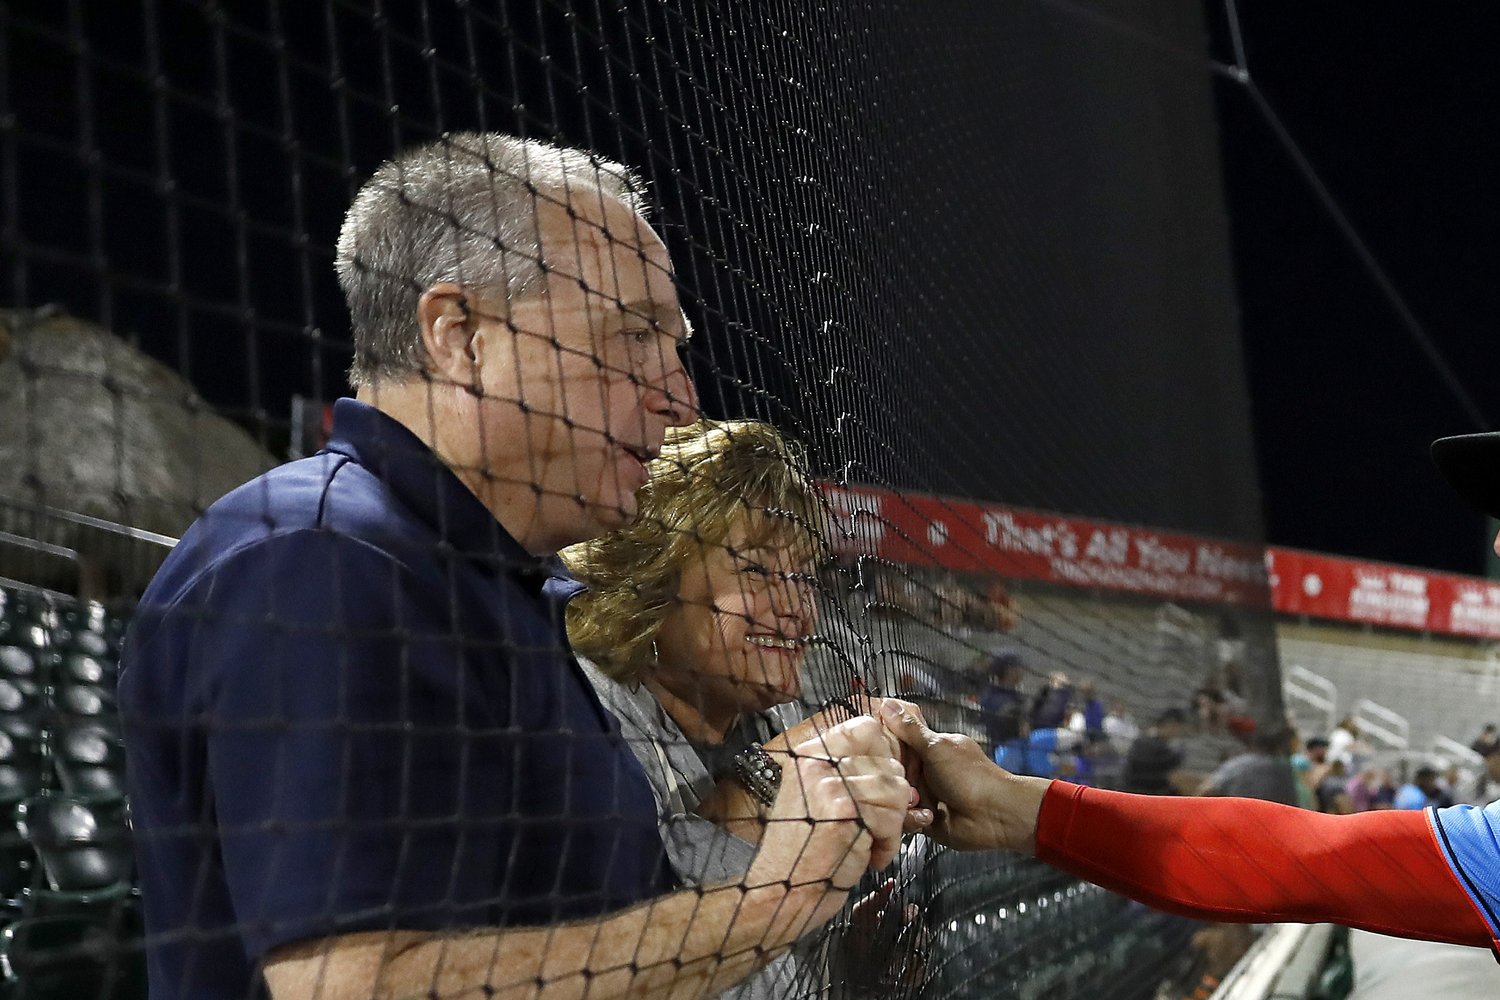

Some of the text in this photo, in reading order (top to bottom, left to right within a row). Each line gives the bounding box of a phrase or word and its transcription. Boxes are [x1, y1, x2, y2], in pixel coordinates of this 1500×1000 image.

[984, 511, 1078, 557] That's
[1087, 530, 1128, 563] All
[1136, 537, 1190, 573] You
